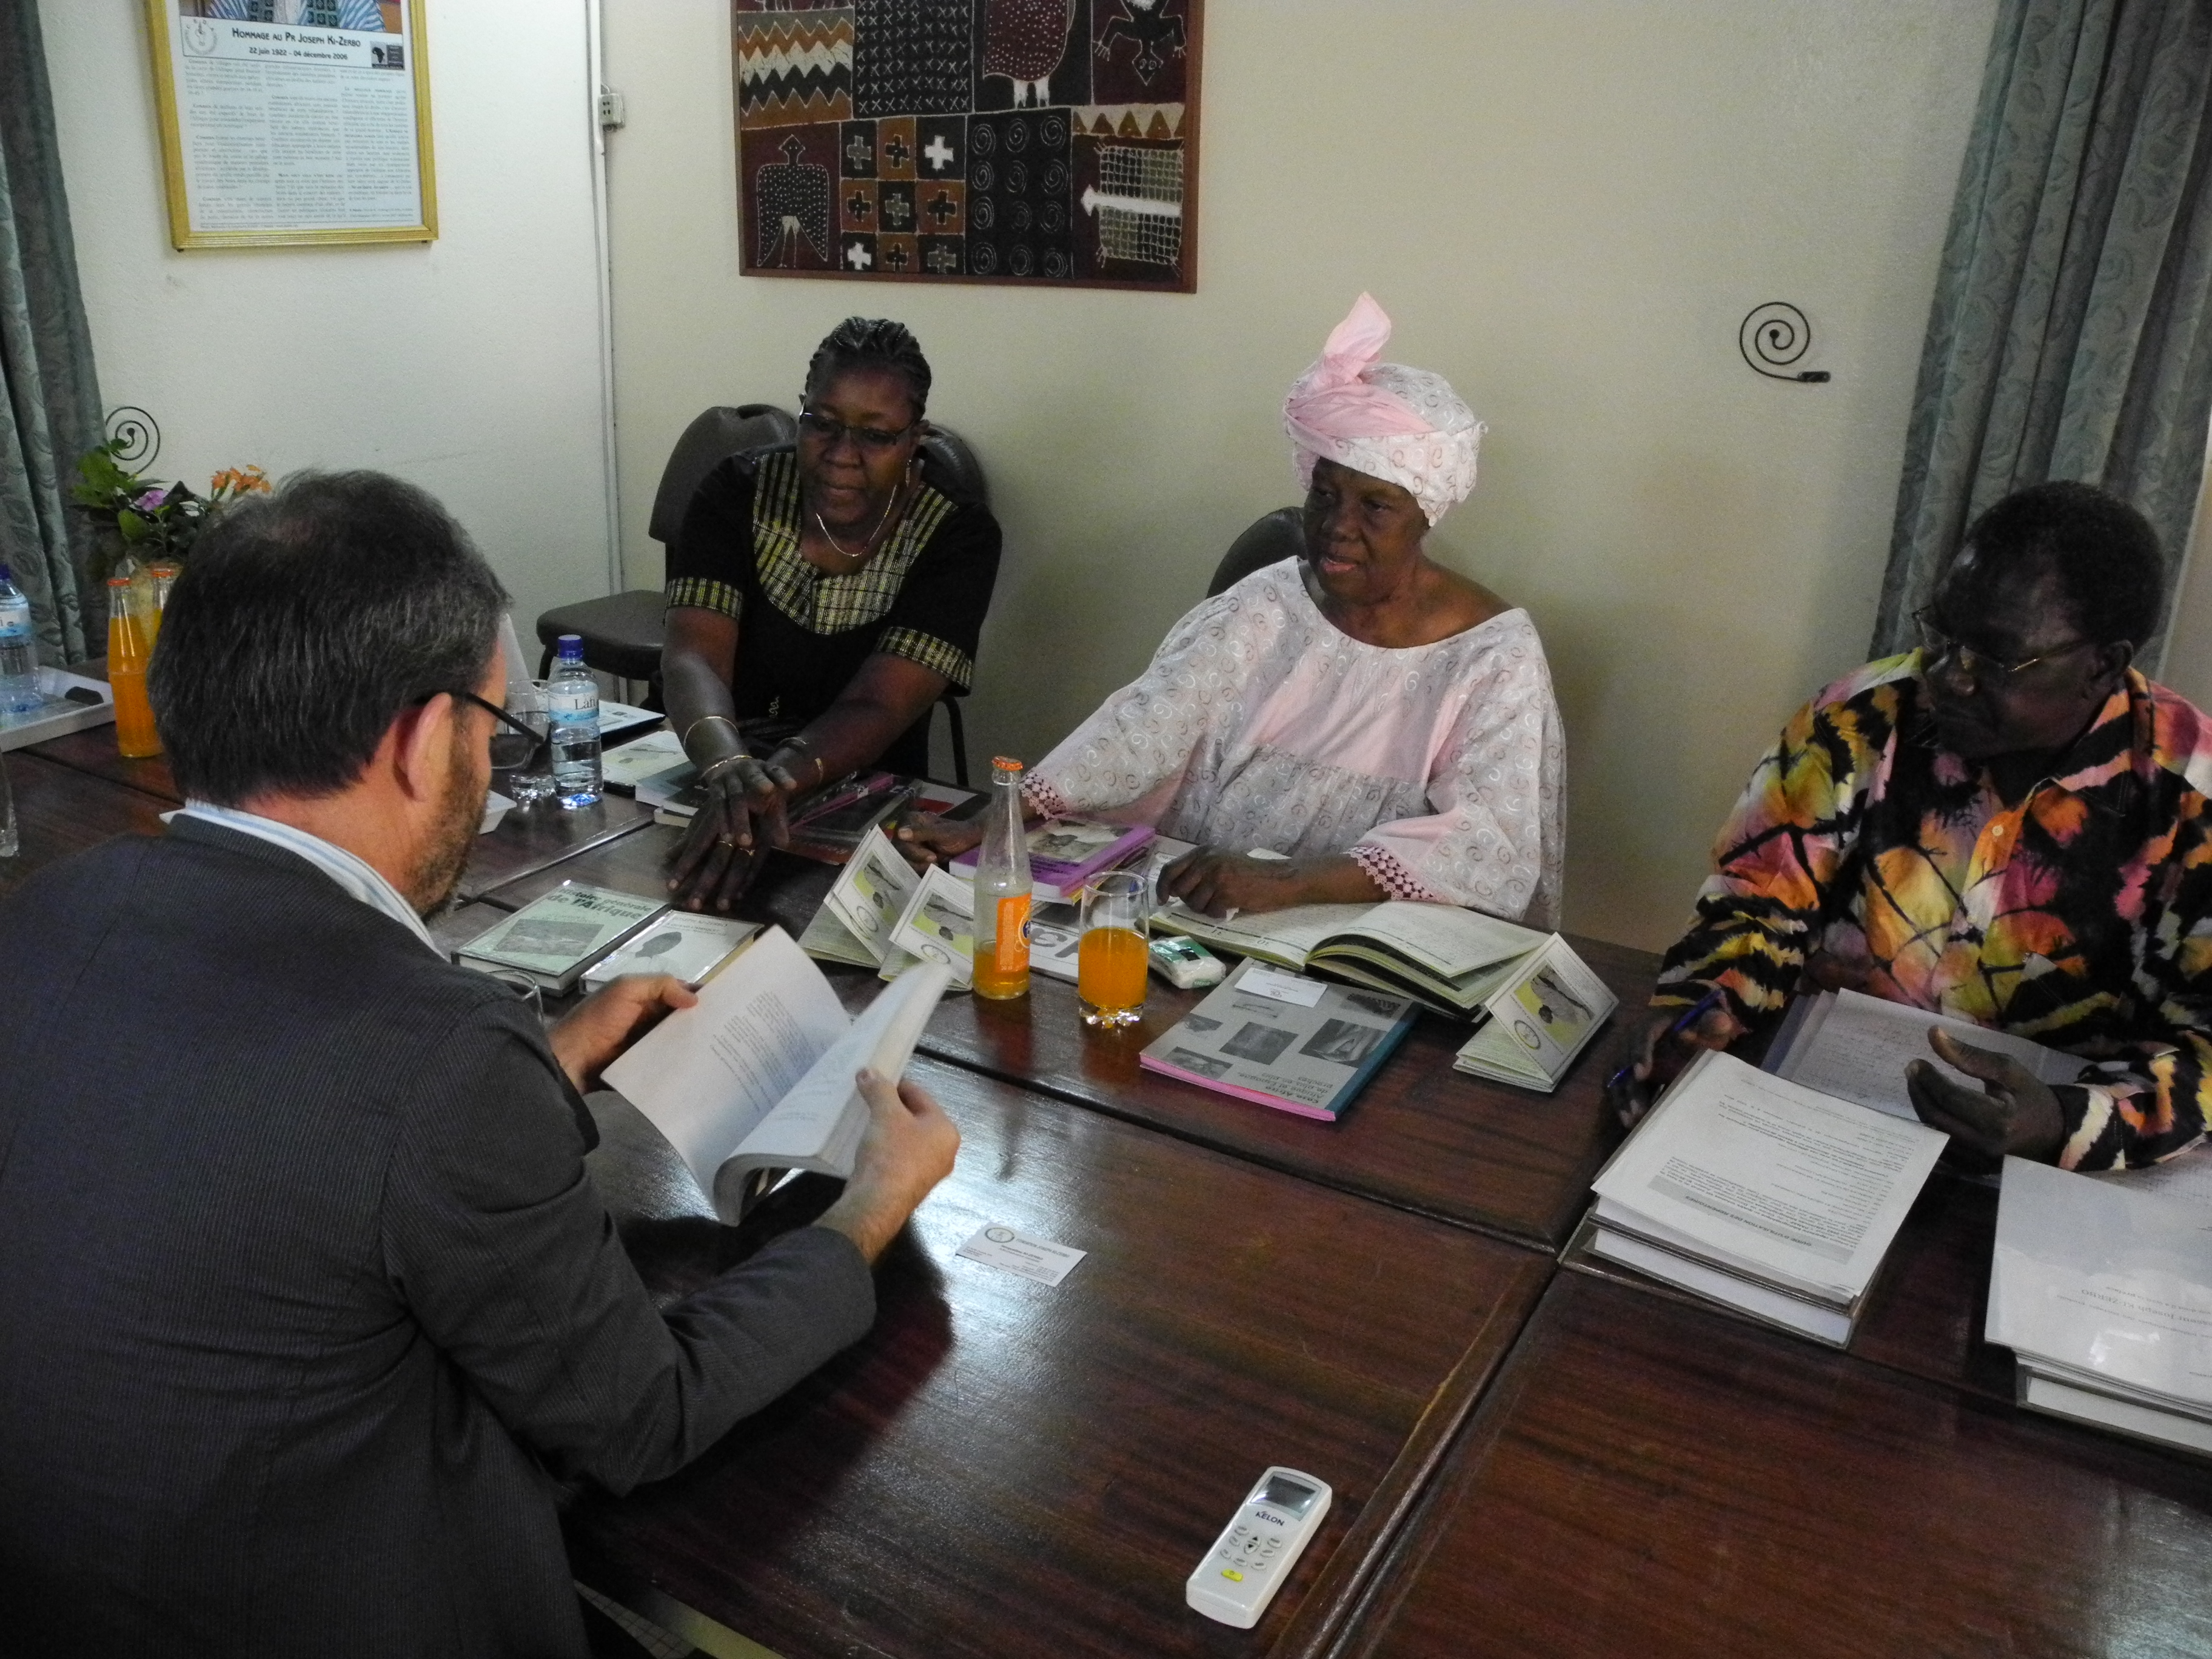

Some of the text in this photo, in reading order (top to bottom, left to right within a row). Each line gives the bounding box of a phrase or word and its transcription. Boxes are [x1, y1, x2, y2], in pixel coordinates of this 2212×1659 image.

[303, 50, 331, 59] décembre
[547, 894, 569, 903] de
[1790, 1236, 1811, 1247] GUIDE
[2081, 1289, 2133, 1308] KI-ZERBO
[2138, 1305, 2174, 1319] Joseph
[1255, 1511, 1285, 1526] KELON
